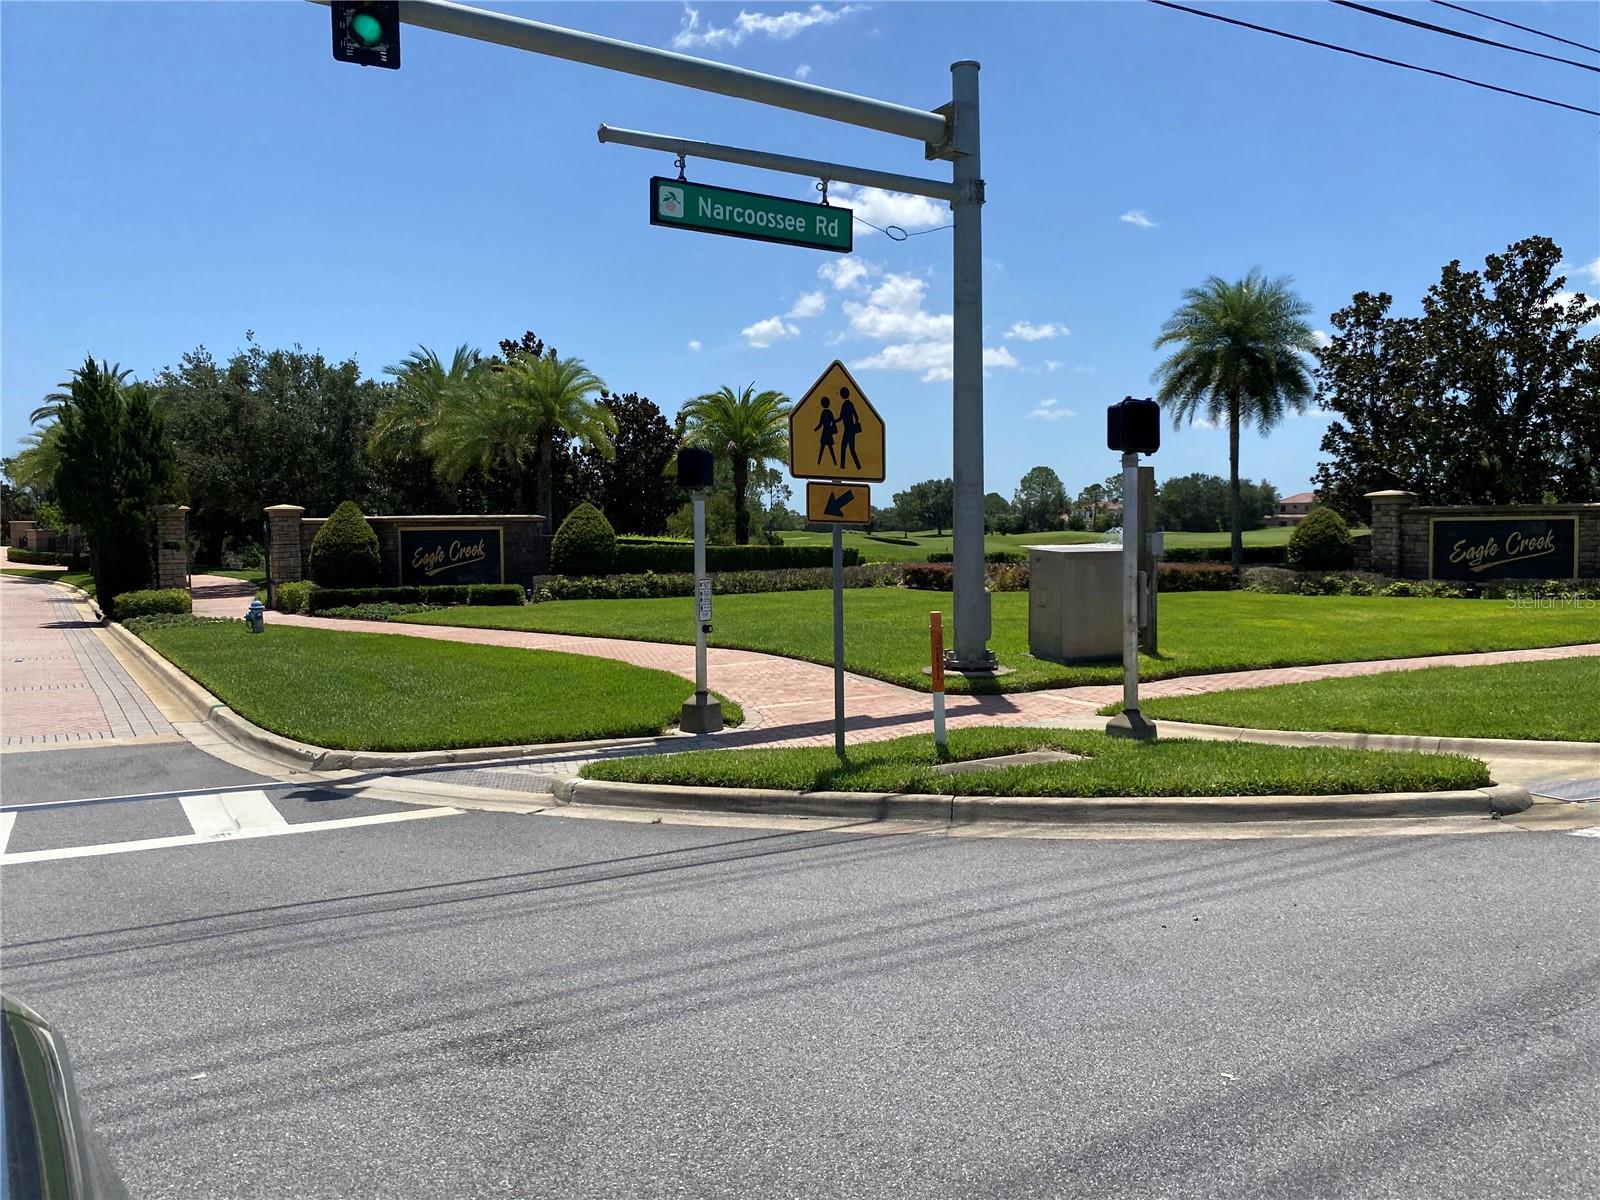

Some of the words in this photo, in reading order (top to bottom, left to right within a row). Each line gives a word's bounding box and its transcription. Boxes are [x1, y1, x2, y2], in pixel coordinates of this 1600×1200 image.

[698, 196, 806, 232] Narcoossee
[815, 215, 839, 238] Rd
[411, 545, 445, 570] Eagle
[449, 538, 486, 561] Creek
[1449, 537, 1500, 566] Eagle
[1505, 529, 1555, 555] Creek
